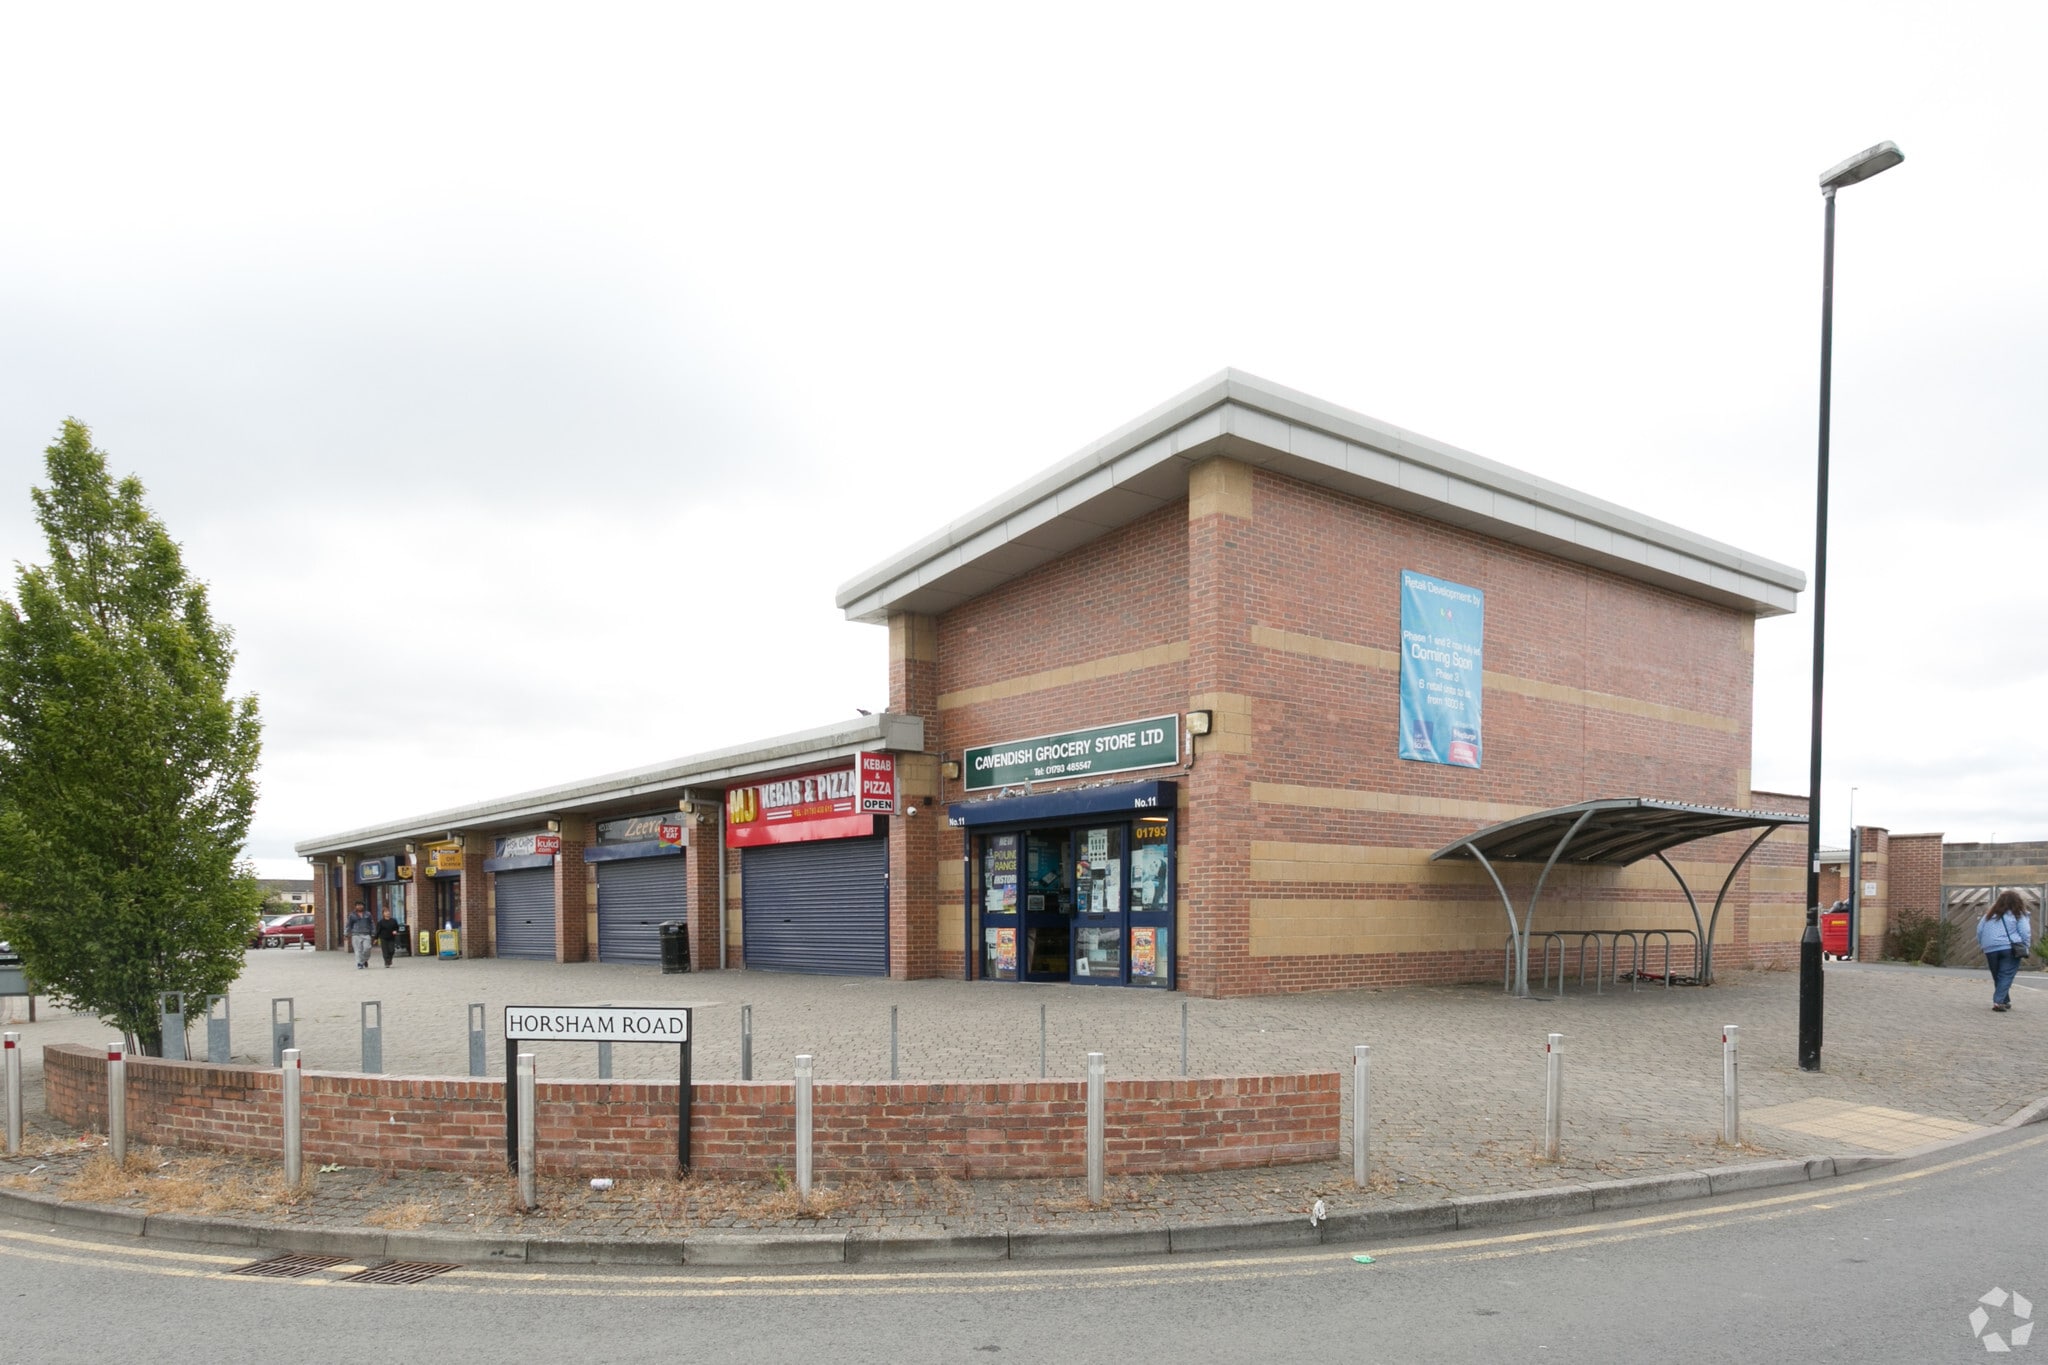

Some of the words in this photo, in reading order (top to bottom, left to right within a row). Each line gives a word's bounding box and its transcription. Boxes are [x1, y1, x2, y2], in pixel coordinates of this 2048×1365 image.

[1404, 575, 1426, 591] Retail
[1427, 581, 1473, 603] Development
[1473, 593, 1481, 608] by
[1403, 630, 1426, 642] Phase
[1446, 638, 1451, 648] 2
[1411, 643, 1450, 668] Coming
[1452, 651, 1473, 671] Soon
[1454, 672, 1460, 682] 3
[1426, 682, 1443, 692] retail
[1427, 694, 1443, 705] from
[975, 747, 1033, 771] CAVENDISH
[1035, 739, 1091, 762] GROCERY
[1095, 732, 1136, 753] STORE
[1140, 728, 1164, 746] LTD
[863, 758, 892, 771] KEBAB
[1034, 766, 1045, 776] Tel:
[1046, 764, 1065, 775] 01793
[1066, 760, 1092, 771] 485547
[863, 780, 892, 795] PIZZA
[730, 787, 757, 824] MJ
[761, 779, 802, 809] KEBAB
[804, 779, 815, 803] &
[817, 770, 857, 801] PIZZA
[864, 799, 892, 809] OPEN
[1134, 796, 1157, 808] No.11
[1136, 826, 1167, 839] 01793
[537, 838, 560, 848] kukd
[510, 1015, 615, 1033] HORSHAM
[622, 1016, 684, 1034] ROAD
